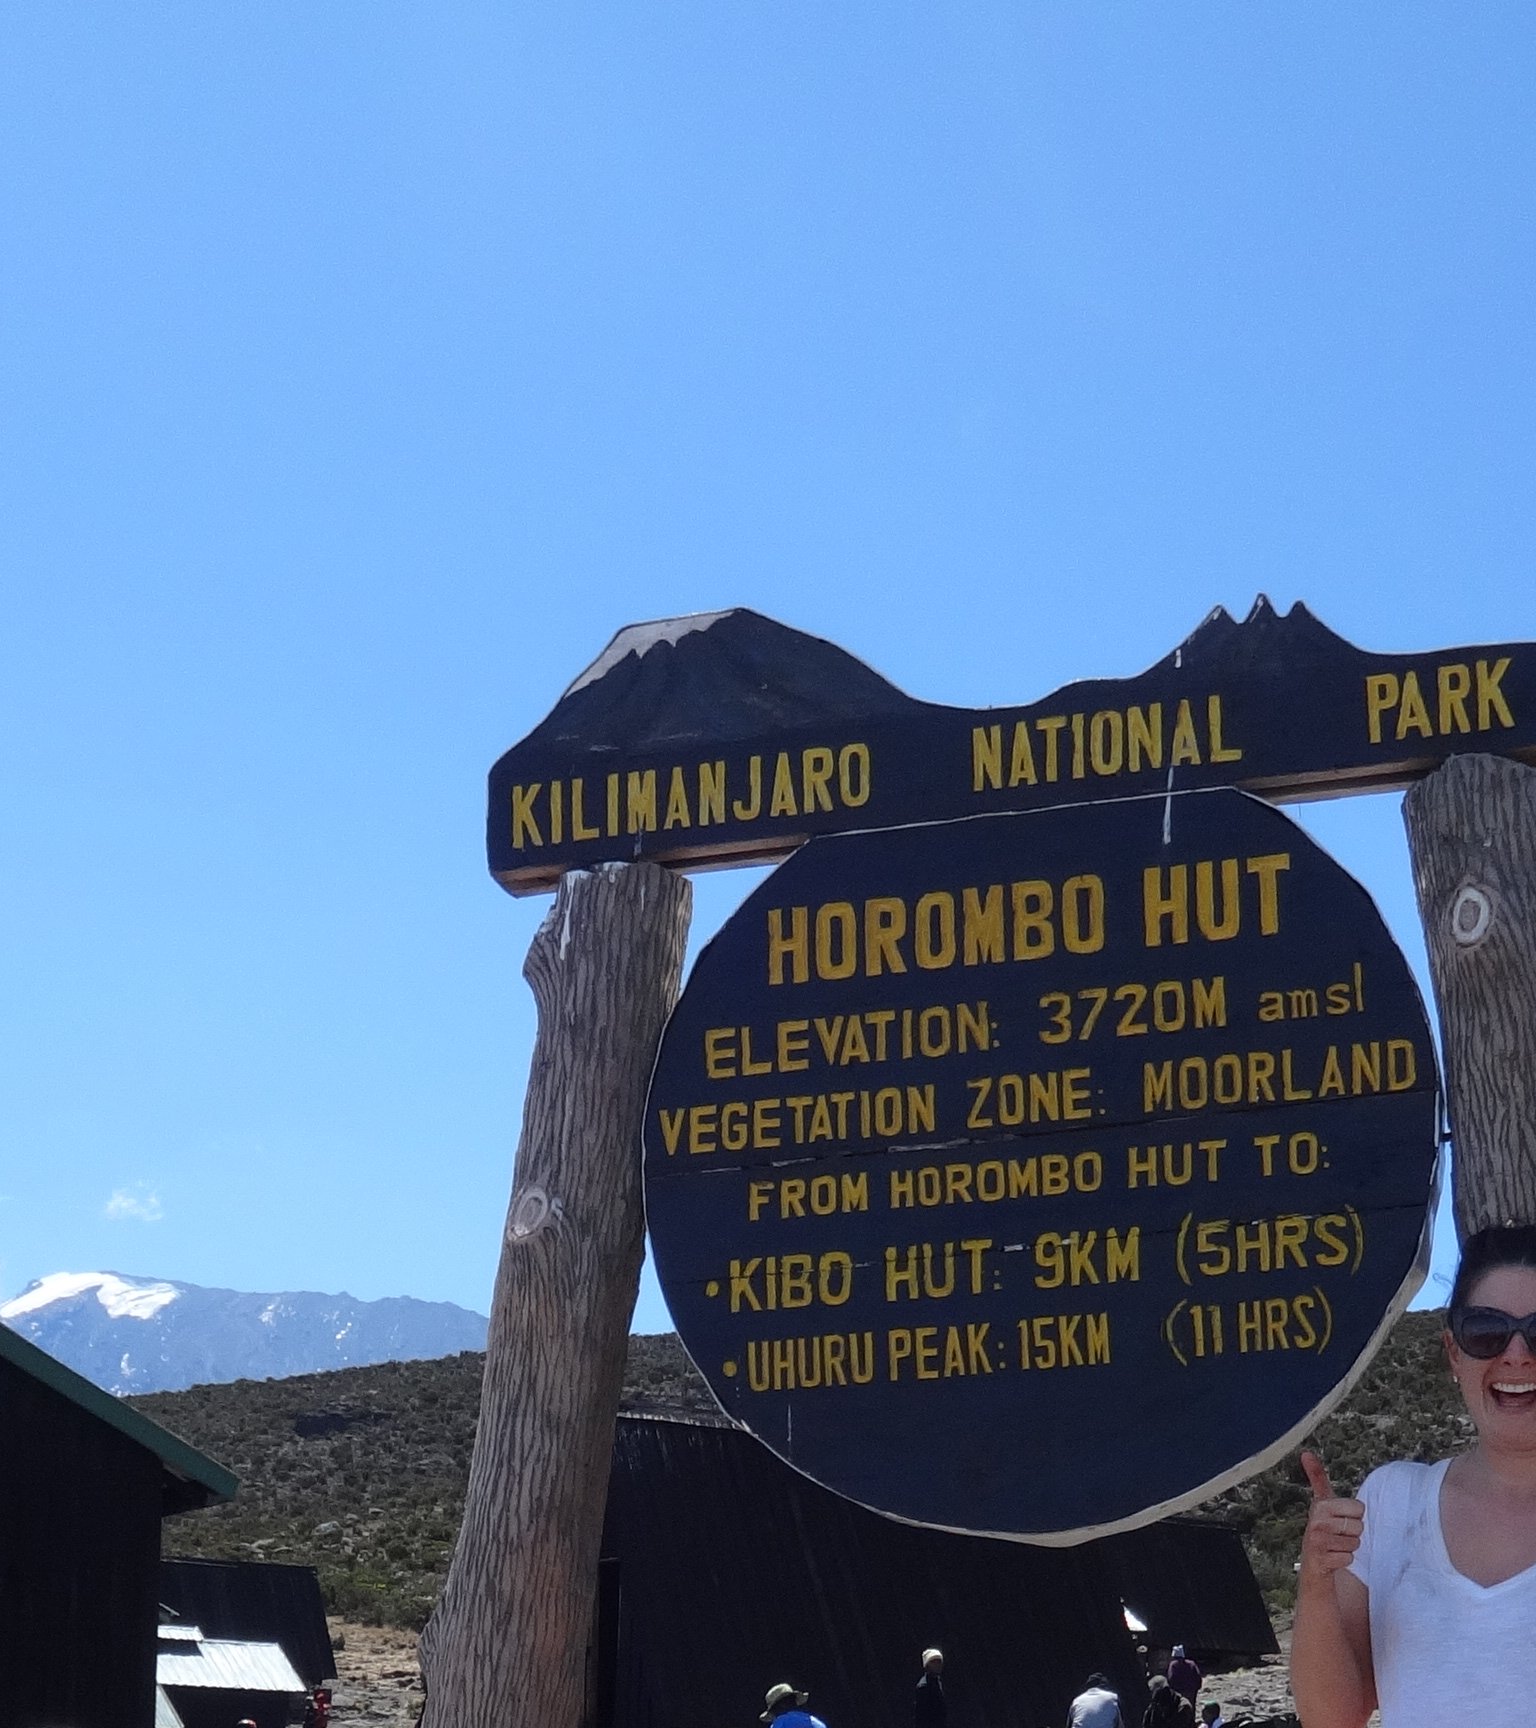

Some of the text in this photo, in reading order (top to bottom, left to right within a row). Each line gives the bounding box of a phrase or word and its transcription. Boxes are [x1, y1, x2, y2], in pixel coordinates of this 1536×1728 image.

[510, 657, 1515, 850] KILIMANJARO NATIONAL PARK
[767, 852, 1292, 987] HOROMBO HUT
[704, 962, 1364, 1080] ELEVATION: 3720M amsl
[659, 1083, 937, 1156] VEGETATION
[1143, 1038, 1418, 1113] MOORLAND
[748, 1131, 1331, 1222] FROM HOROMBO HUT TO:
[728, 1250, 853, 1314] KIBO
[1034, 1226, 1142, 1291] 9KM
[1175, 1204, 1365, 1287] (5HRS)
[747, 1331, 876, 1393] UHURU
[1017, 1313, 1112, 1371] 15KM
